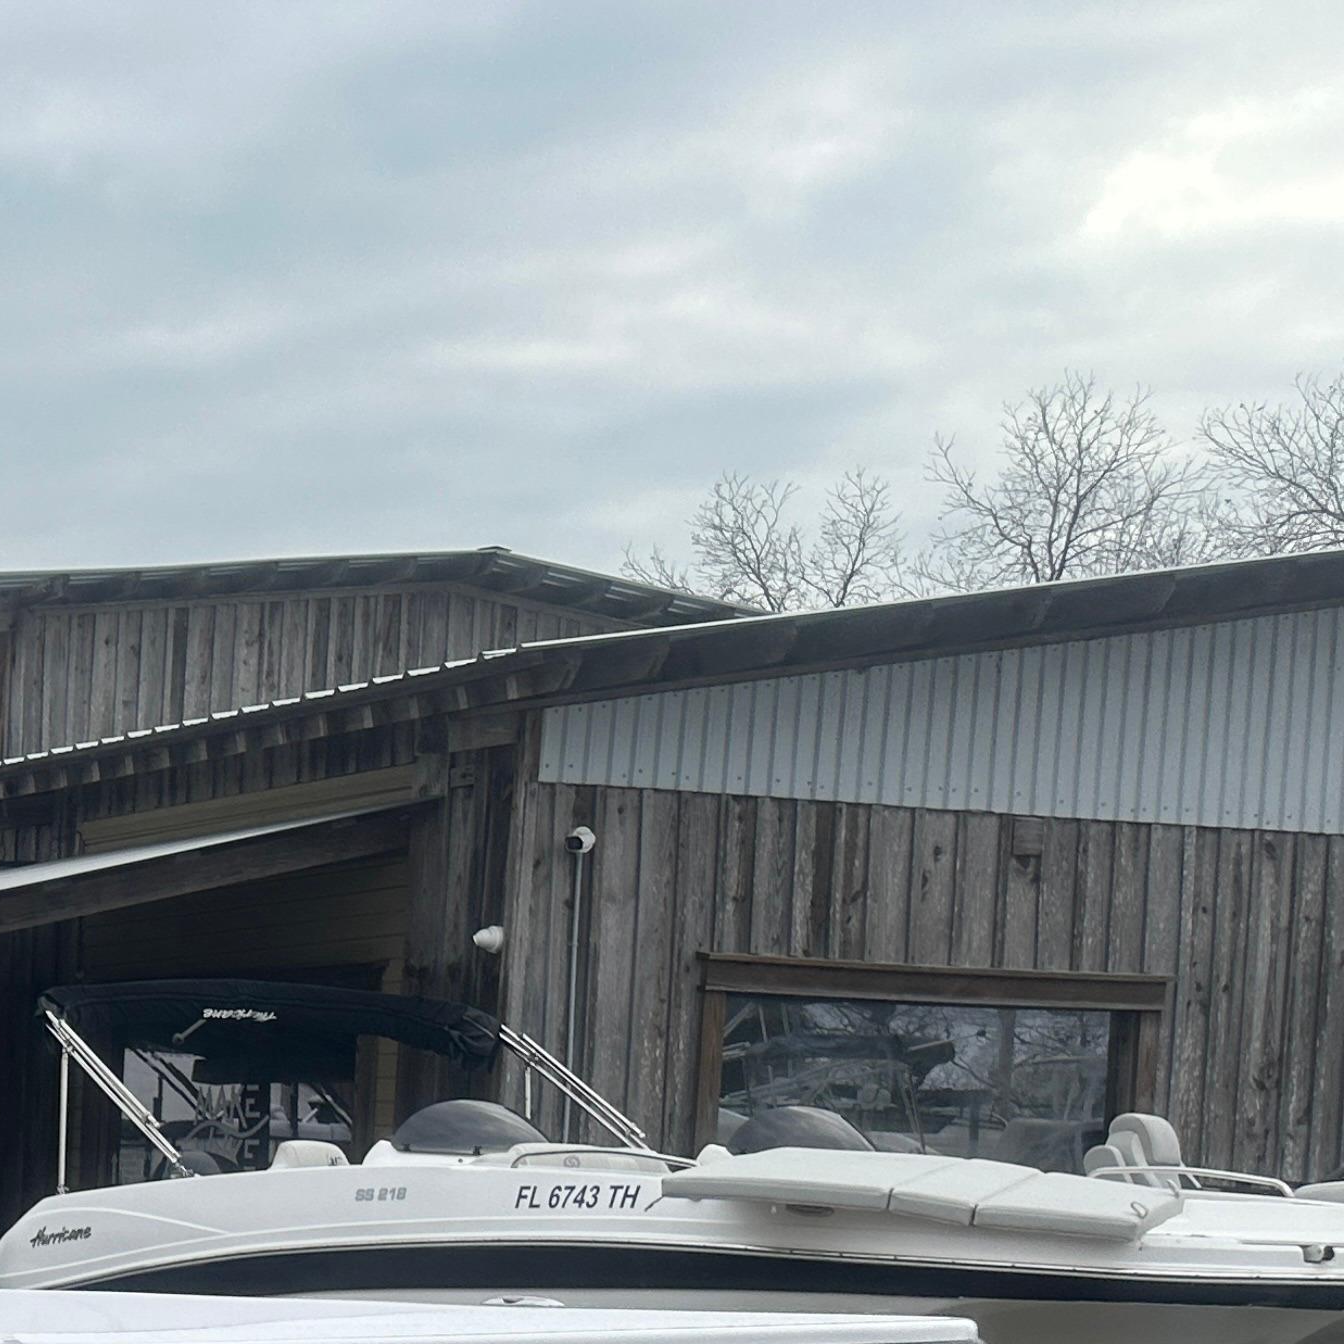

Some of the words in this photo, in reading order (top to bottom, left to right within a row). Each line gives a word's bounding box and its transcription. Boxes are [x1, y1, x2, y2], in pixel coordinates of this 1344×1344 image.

[355, 1188, 375, 1202] SS
[514, 1185, 541, 1209] FL
[548, 1185, 600, 1209] 6743
[608, 1185, 641, 1209] TH
[30, 1226, 92, 1248] Hurricane
